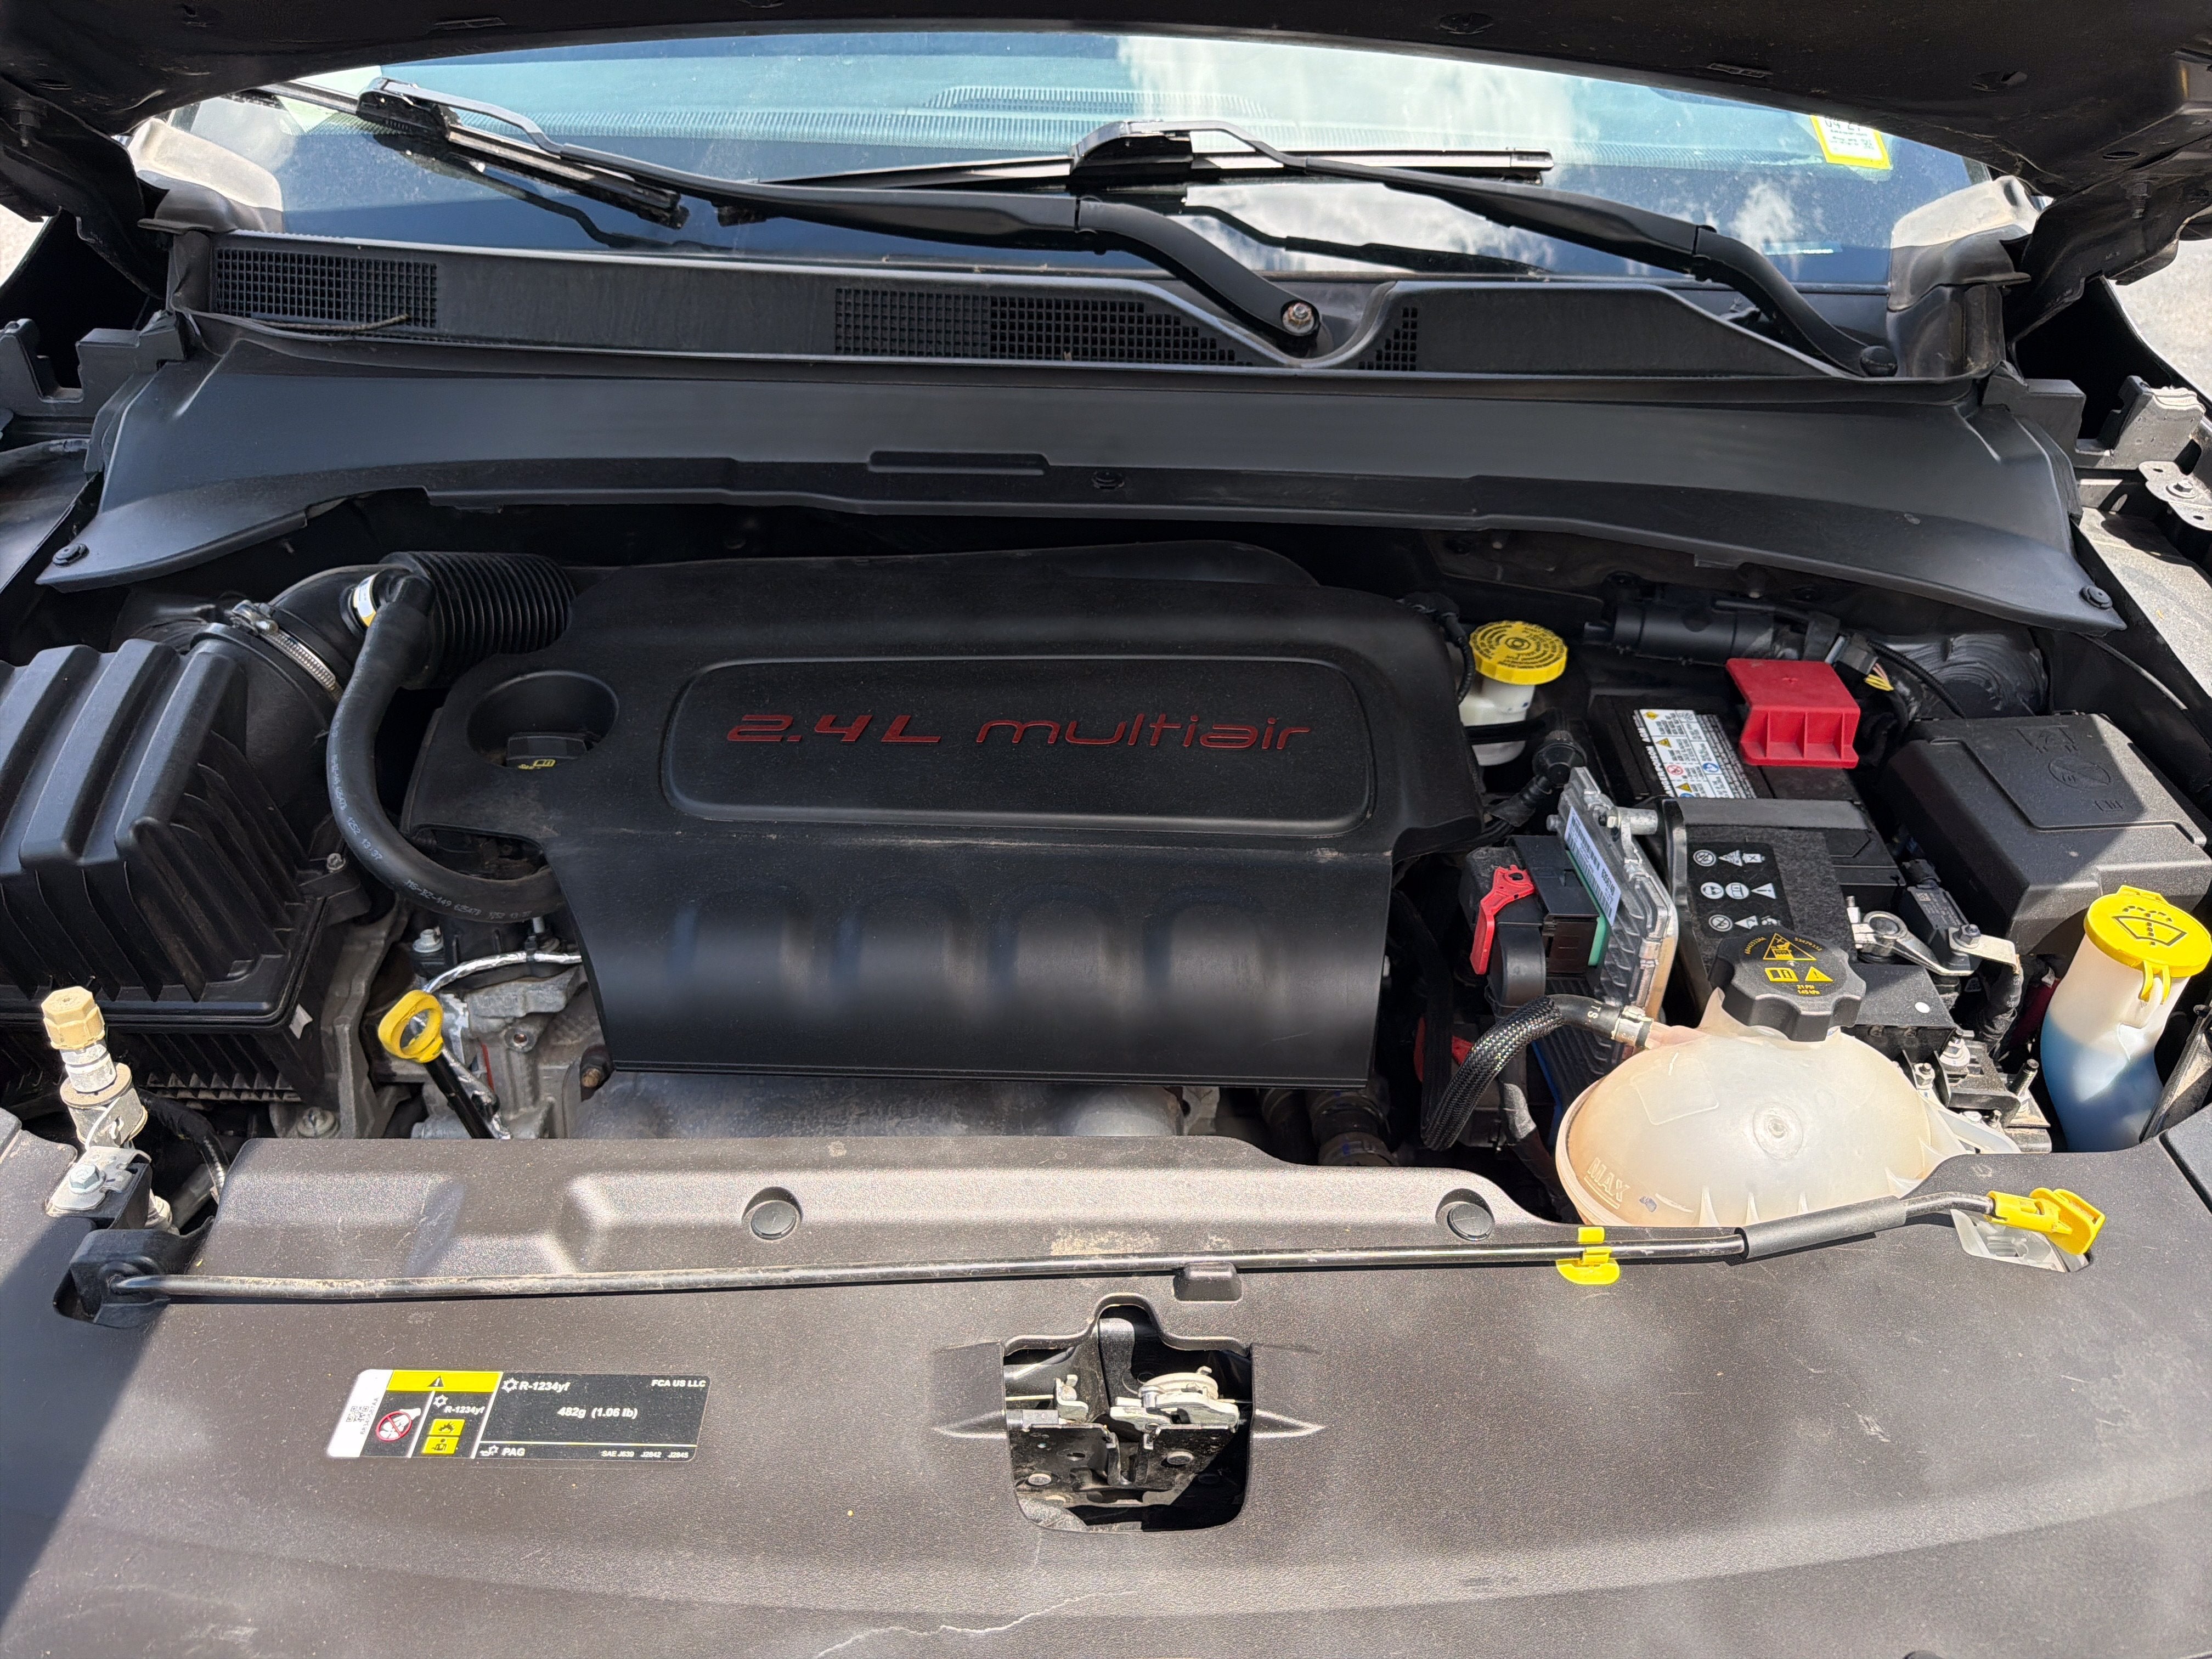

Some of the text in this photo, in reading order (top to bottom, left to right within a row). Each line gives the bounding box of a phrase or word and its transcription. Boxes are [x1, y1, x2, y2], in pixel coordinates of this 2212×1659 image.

[977, 714, 1310, 749] multiair
[1587, 1157, 1630, 1203] MAX
[519, 1381, 571, 1393] R-1234yf
[443, 1406, 486, 1415] R-1234yf
[557, 1407, 586, 1418] 482g
[501, 1447, 526, 1457] PAG
